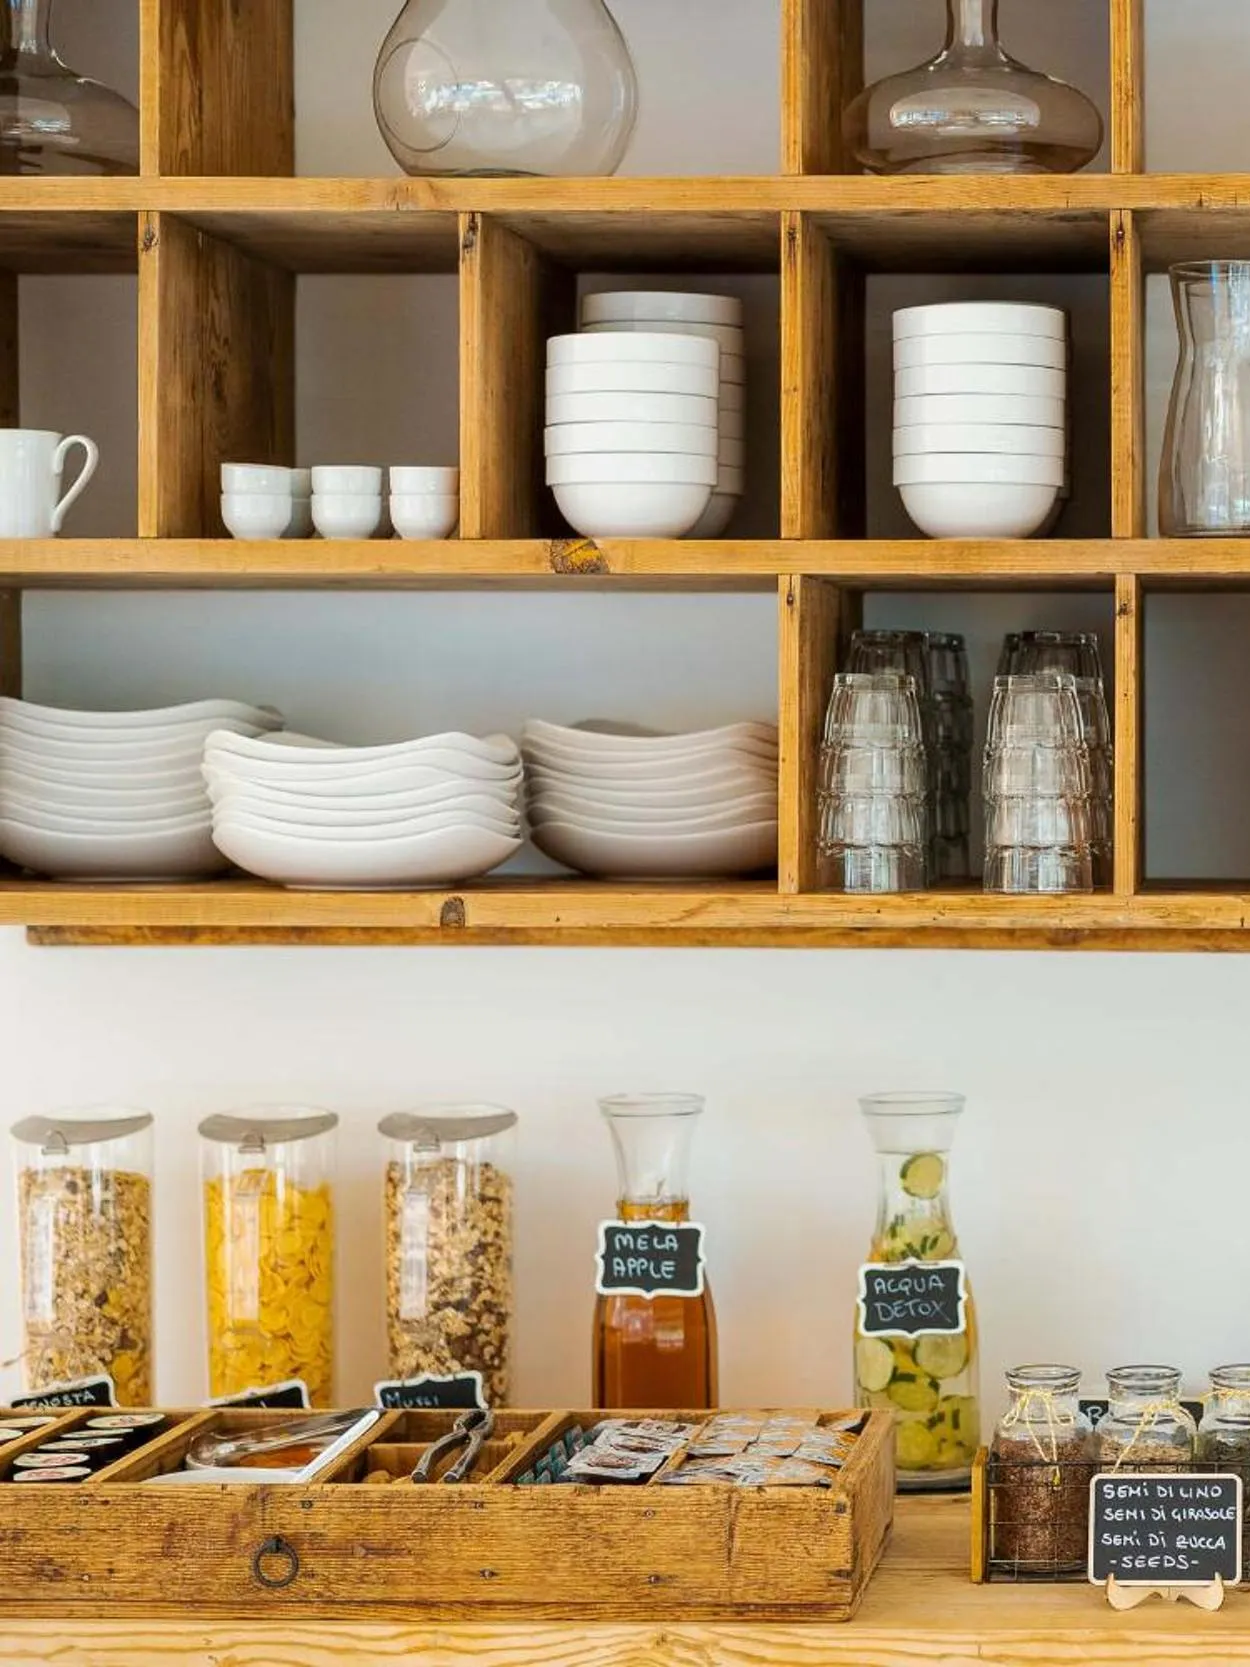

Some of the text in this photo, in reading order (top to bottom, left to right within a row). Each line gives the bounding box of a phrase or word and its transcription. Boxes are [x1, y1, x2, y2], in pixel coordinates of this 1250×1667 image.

[614, 1233, 679, 1251] MELA
[613, 1257, 676, 1280] APPLE
[873, 1274, 946, 1297] ACQUA
[873, 1299, 952, 1324] DETOX
[1179, 1485, 1223, 1498] LINO
[1103, 1508, 1145, 1521] SEMI
[1171, 1506, 1236, 1522] GIRASOLE
